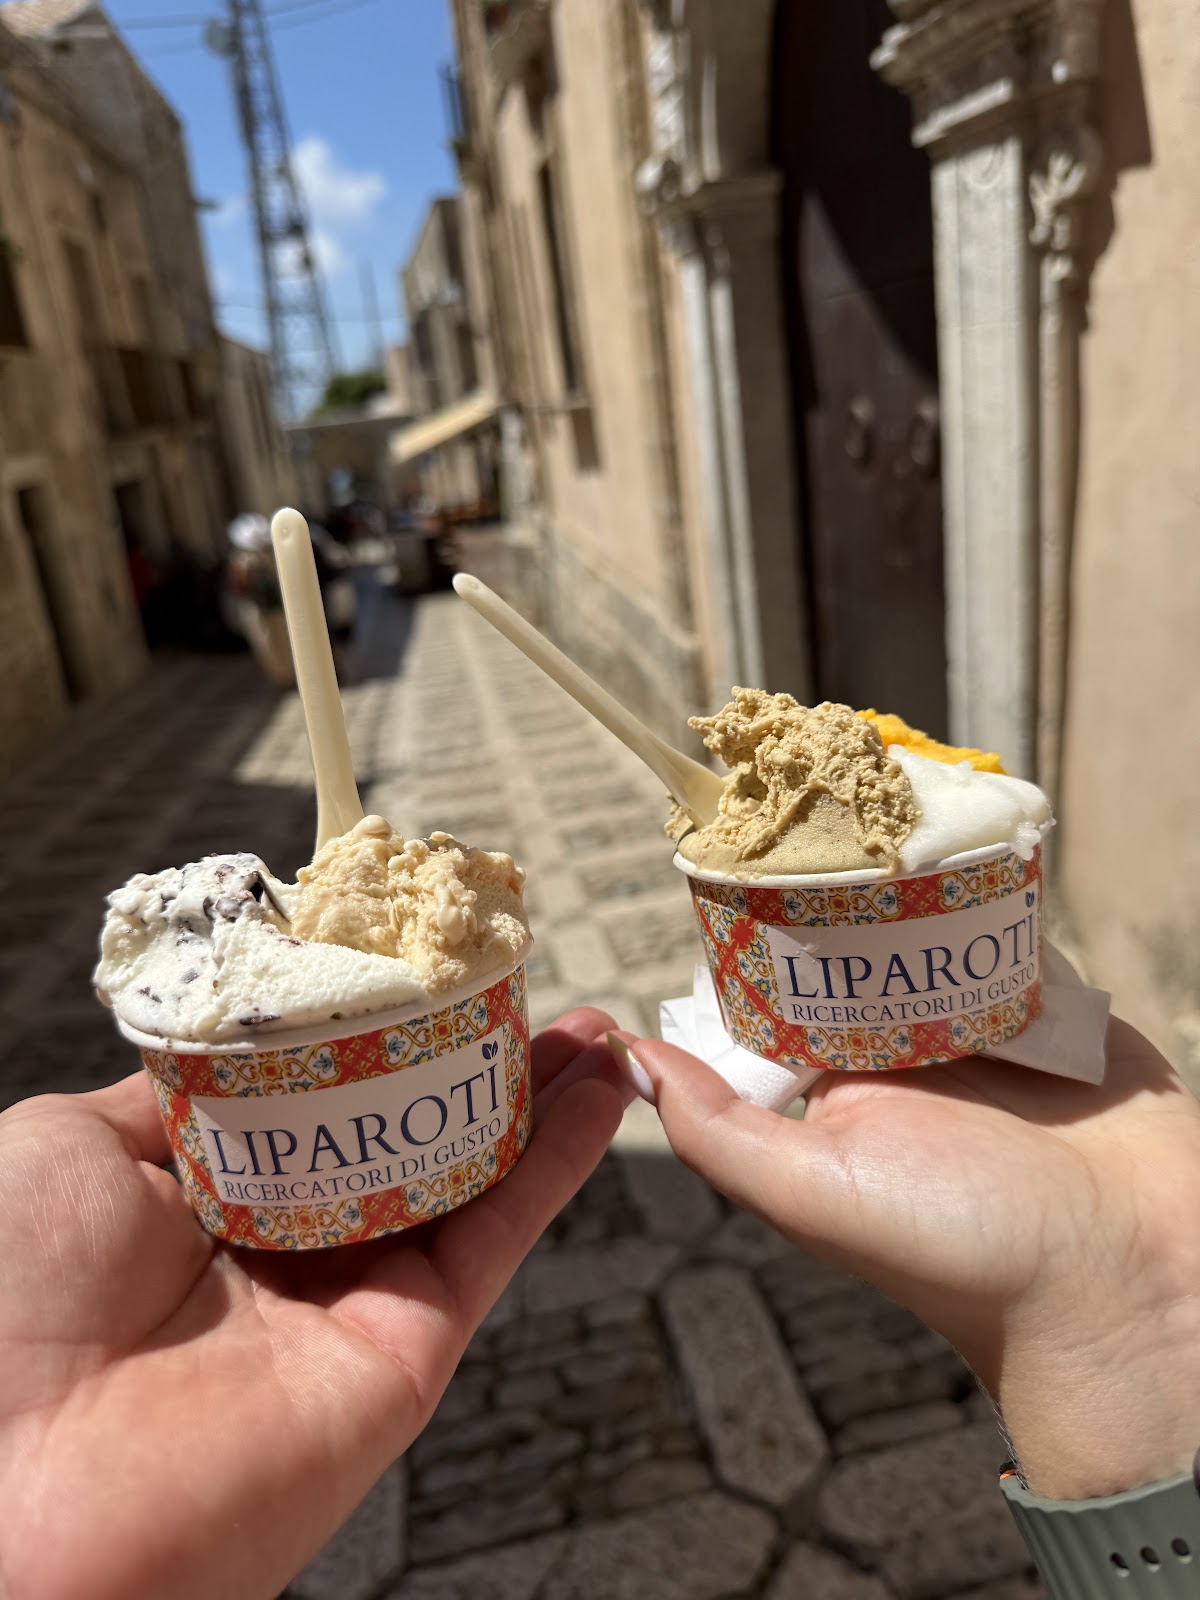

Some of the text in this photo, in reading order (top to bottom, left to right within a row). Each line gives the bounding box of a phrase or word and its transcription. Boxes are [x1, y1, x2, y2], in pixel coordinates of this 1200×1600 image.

[781, 912, 1035, 999] LIPAROTI
[791, 962, 1035, 1023] RICERCATORI DI GUSTO
[207, 1063, 501, 1176] LIPAROTI
[223, 1117, 501, 1201] RICERCATORI DI GUSTO
